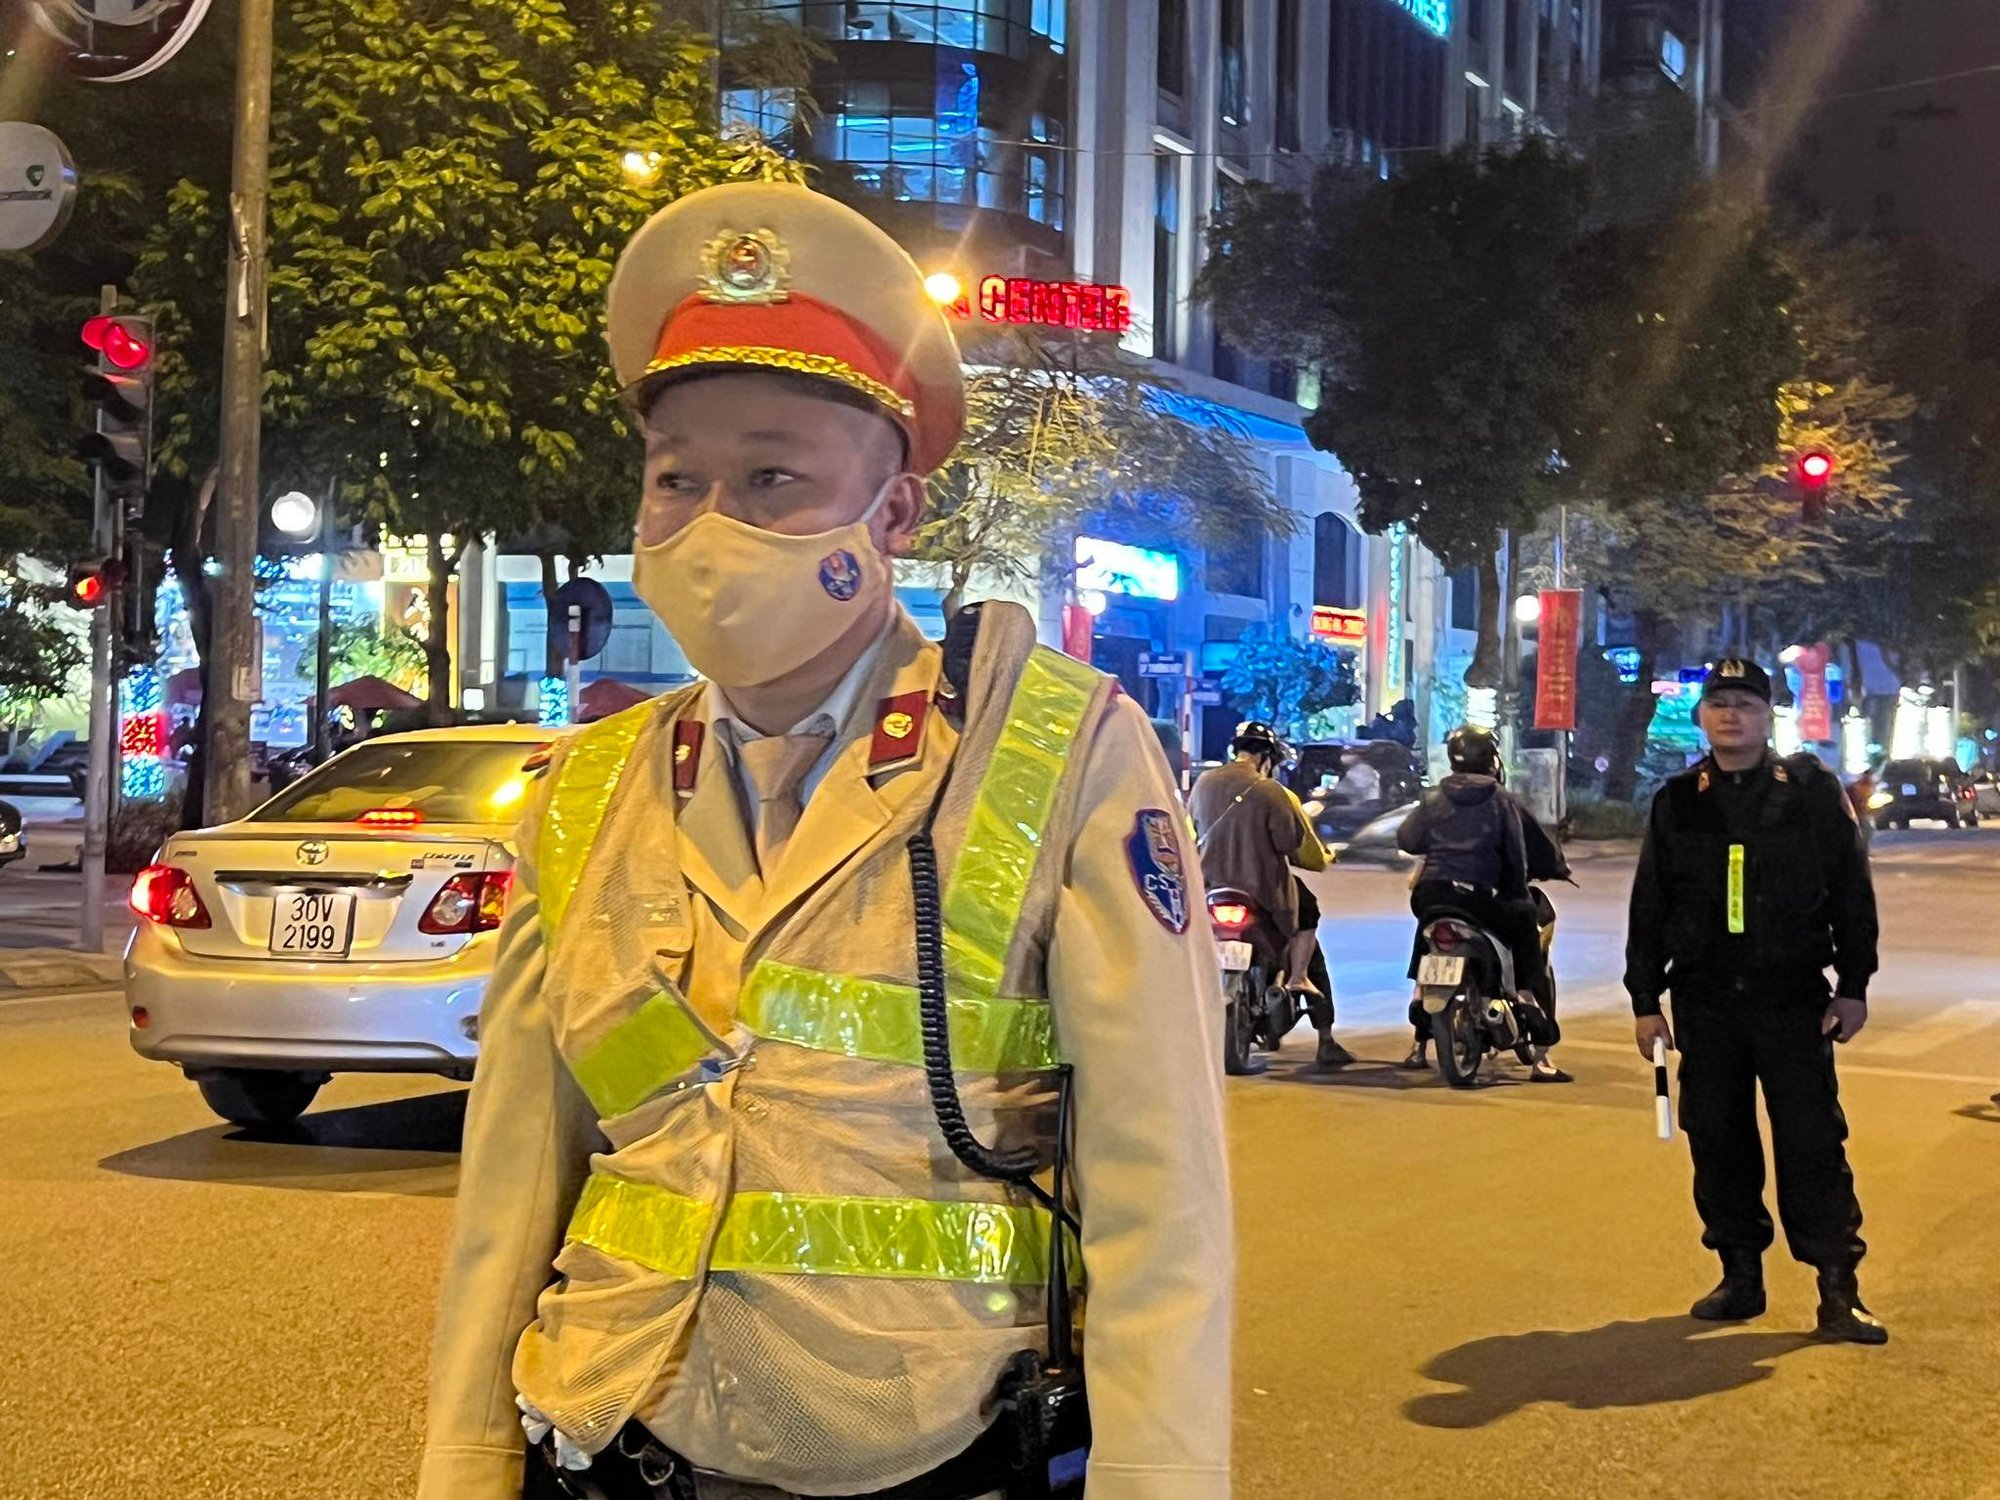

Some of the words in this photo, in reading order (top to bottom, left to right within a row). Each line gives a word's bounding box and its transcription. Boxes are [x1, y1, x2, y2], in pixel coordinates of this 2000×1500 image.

[980, 275, 1130, 331] CENTER
[291, 896, 334, 922] 30V
[283, 924, 335, 949] 2199
